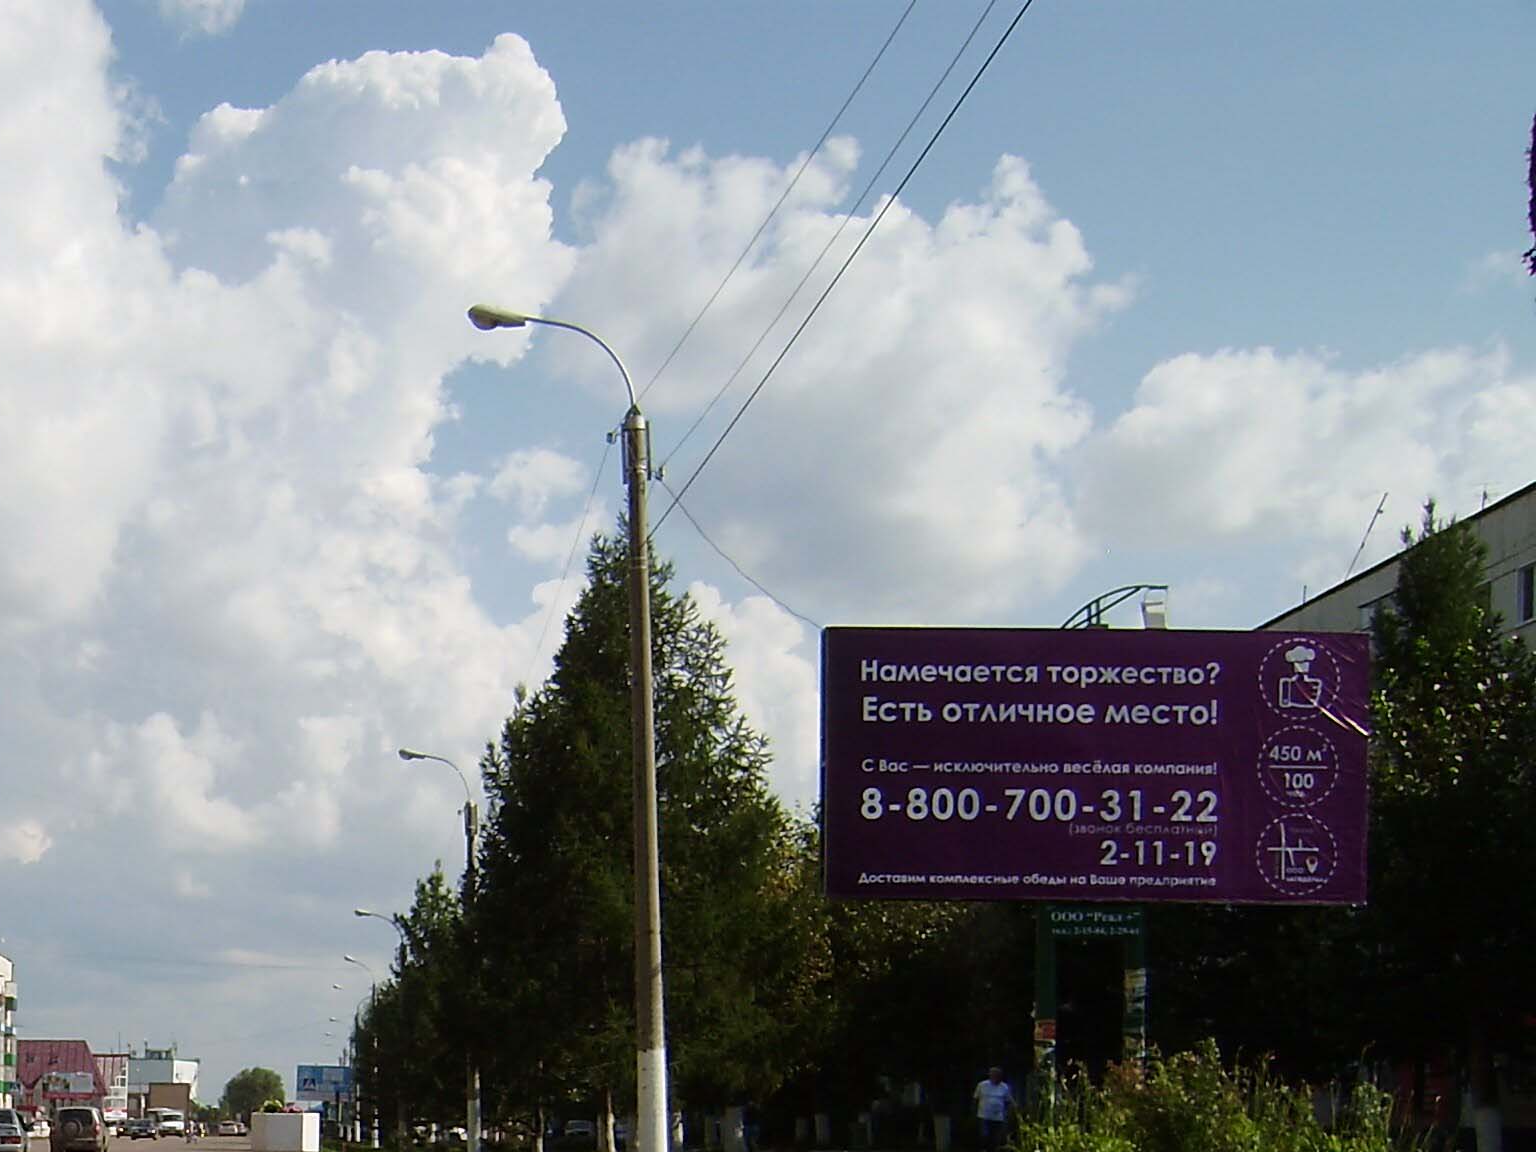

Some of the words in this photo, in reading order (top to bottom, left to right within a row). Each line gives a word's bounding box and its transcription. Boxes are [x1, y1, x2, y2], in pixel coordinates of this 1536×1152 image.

[860, 660, 1039, 683] Намечается
[1046, 662, 1221, 688] торжество?
[862, 696, 933, 722] Есть
[942, 703, 1096, 723] отличное
[1104, 700, 1218, 724] место!
[1269, 746, 1301, 761] 450
[861, 759, 875, 773] С
[878, 760, 909, 773] Вас
[934, 761, 1059, 774] исключительно
[1063, 760, 1130, 775] весёлая
[1134, 762, 1218, 776] компания!
[1284, 772, 1314, 789] 100
[860, 787, 1218, 823] 8-800-700-31-22
[1100, 840, 1217, 866] 2-11-19
[858, 872, 926, 885] Доставим
[929, 873, 1019, 886] комплексные
[1023, 872, 1066, 886] обеды
[1070, 876, 1086, 886] на
[1089, 874, 1125, 886] Ваше
[1129, 875, 1217, 887] предприятие
[1050, 911, 1084, 921] ООО
